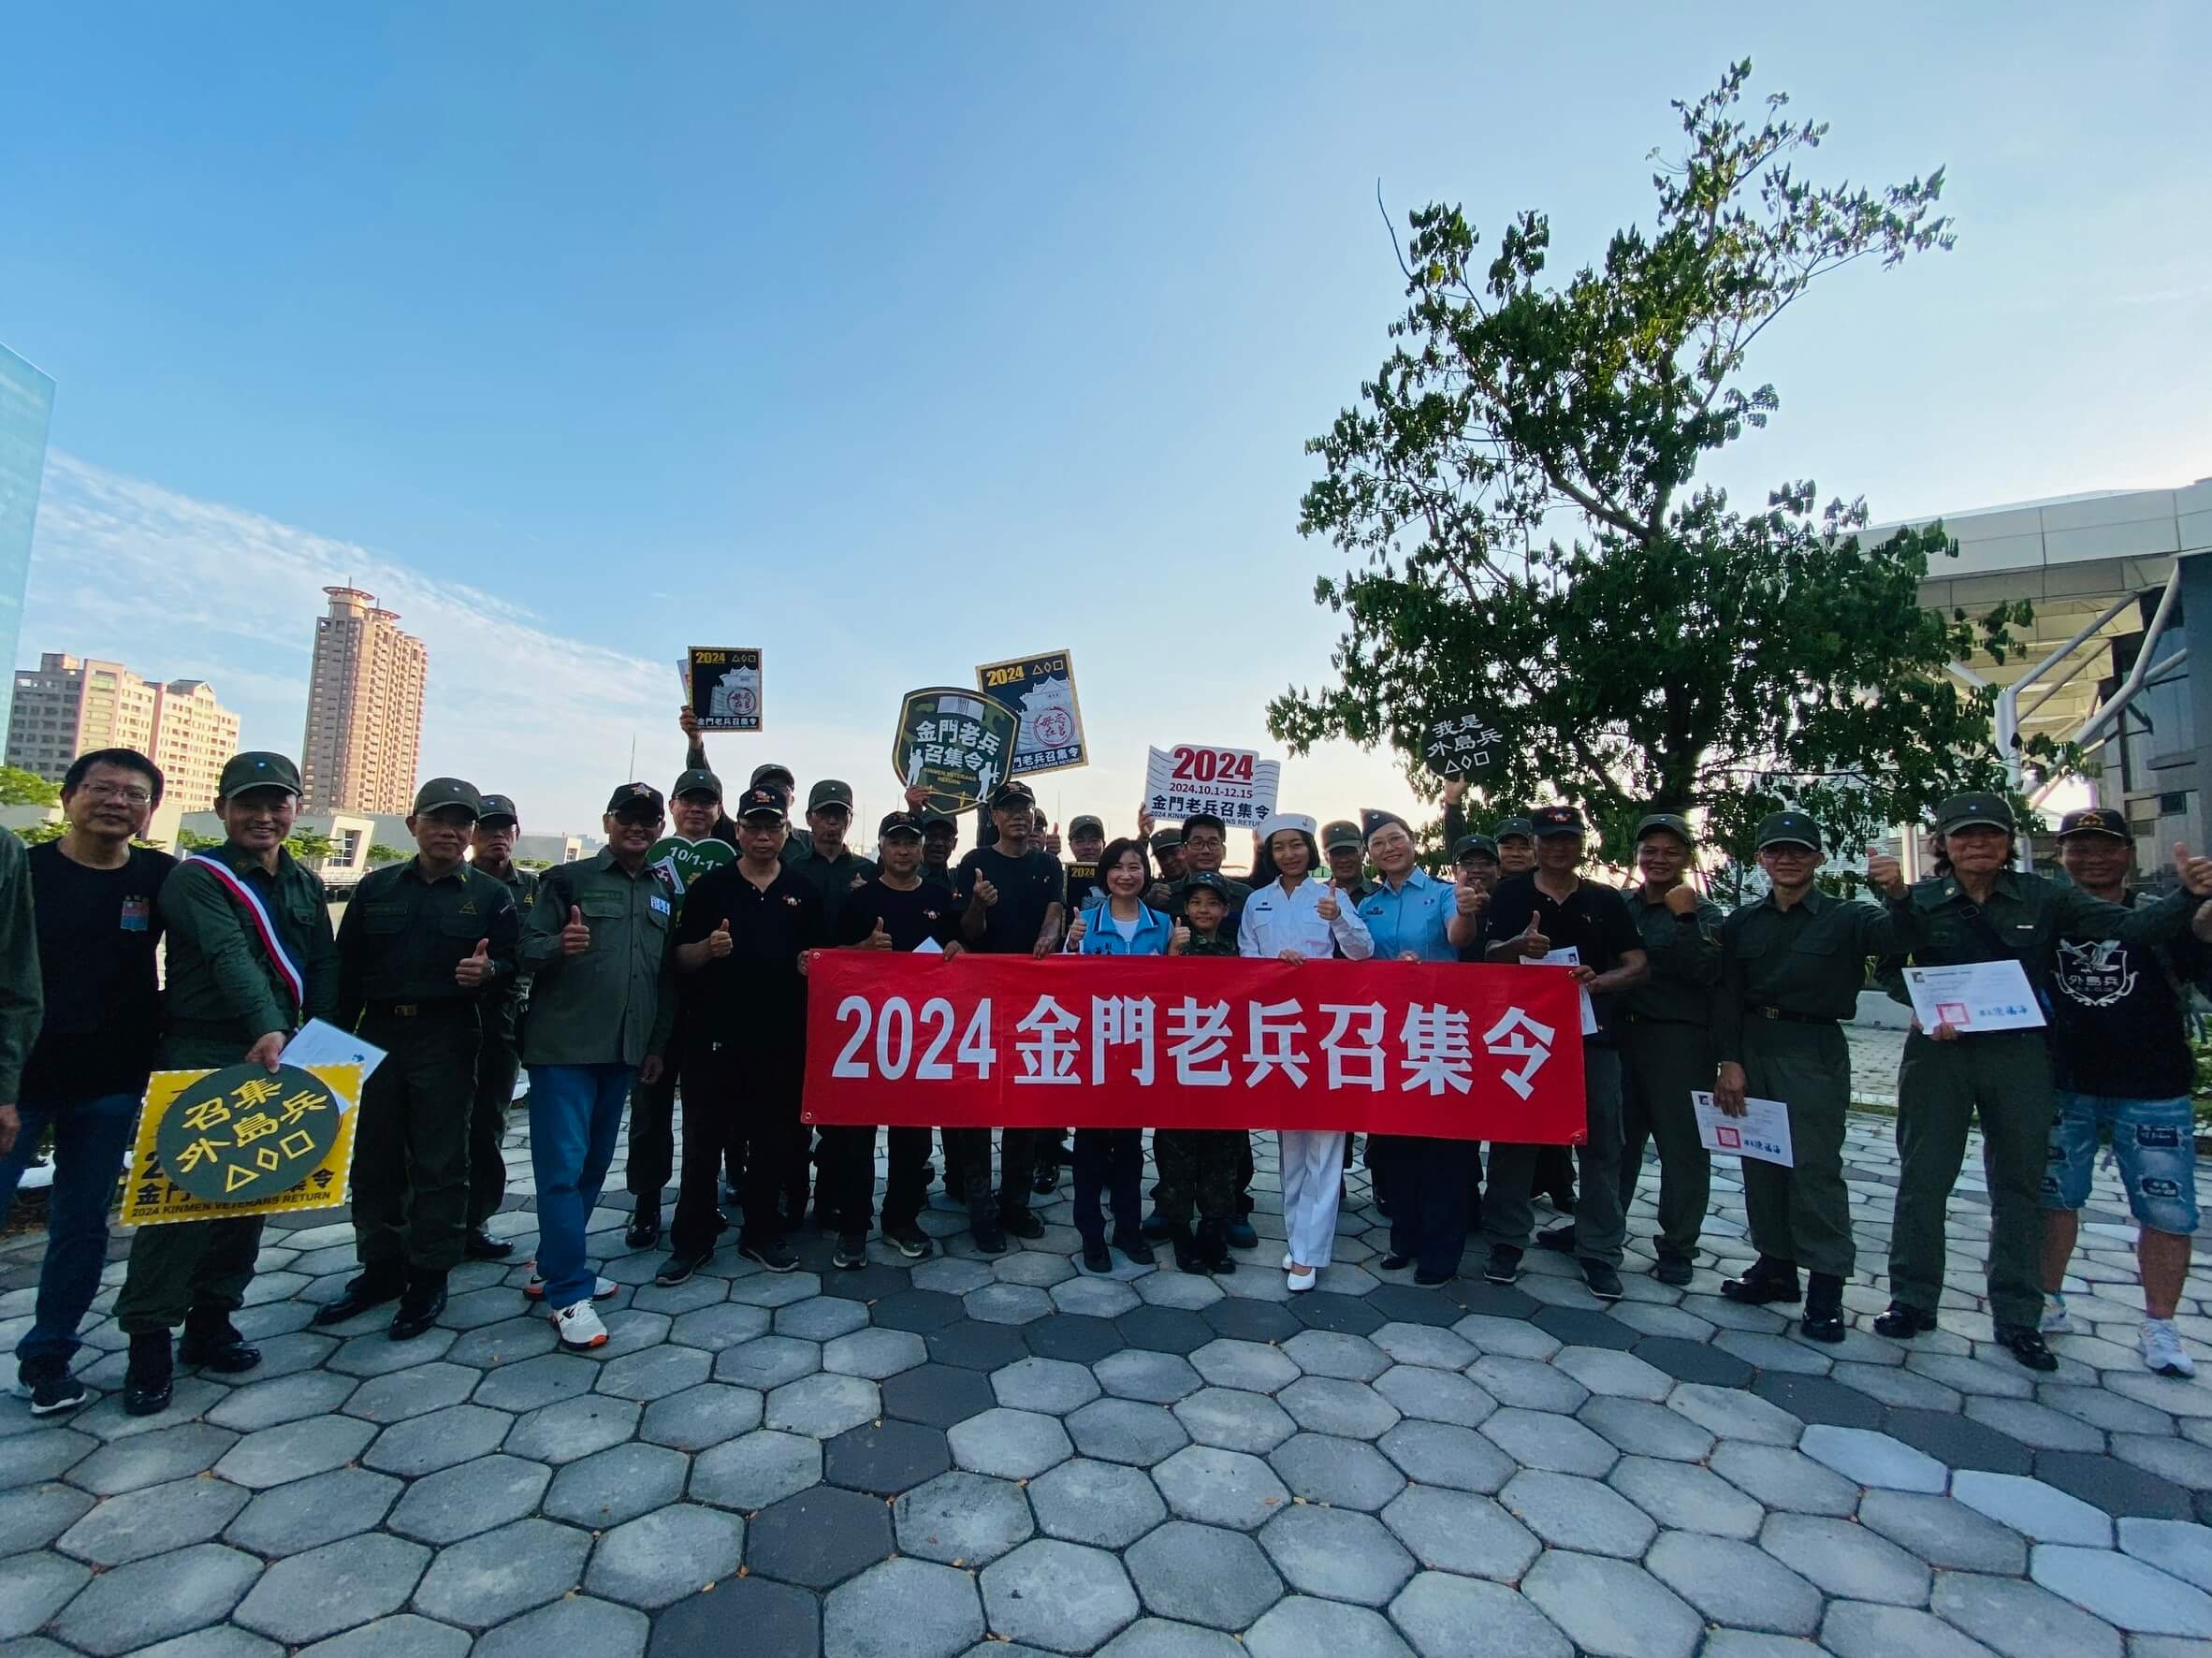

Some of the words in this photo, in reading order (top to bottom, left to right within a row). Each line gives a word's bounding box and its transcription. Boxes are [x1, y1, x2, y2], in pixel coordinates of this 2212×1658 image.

[695, 651, 726, 663] 2024
[986, 665, 1025, 687] 2024
[916, 719, 1000, 756] 金門老兵
[1432, 714, 1483, 738] 我是
[1428, 728, 1503, 757] 外島兵
[924, 743, 983, 771] 召集令
[1012, 747, 1079, 768] 門老兵召集令
[1171, 748, 1254, 782] 2024
[1170, 782, 1253, 799] 2024.10.1-12.15
[1151, 794, 1270, 820] 金門老兵召集令
[669, 846, 723, 871] 10/1-1
[1070, 866, 1096, 878] 2024
[832, 994, 997, 1080] 2024
[1013, 994, 1557, 1102] 金門老兵召集令
[182, 1078, 283, 1131] 召集
[175, 1089, 327, 1173] 外島兵
[131, 1206, 160, 1217] 2024
[163, 1203, 211, 1215] KINMEN
[283, 1190, 331, 1203] RETURN
